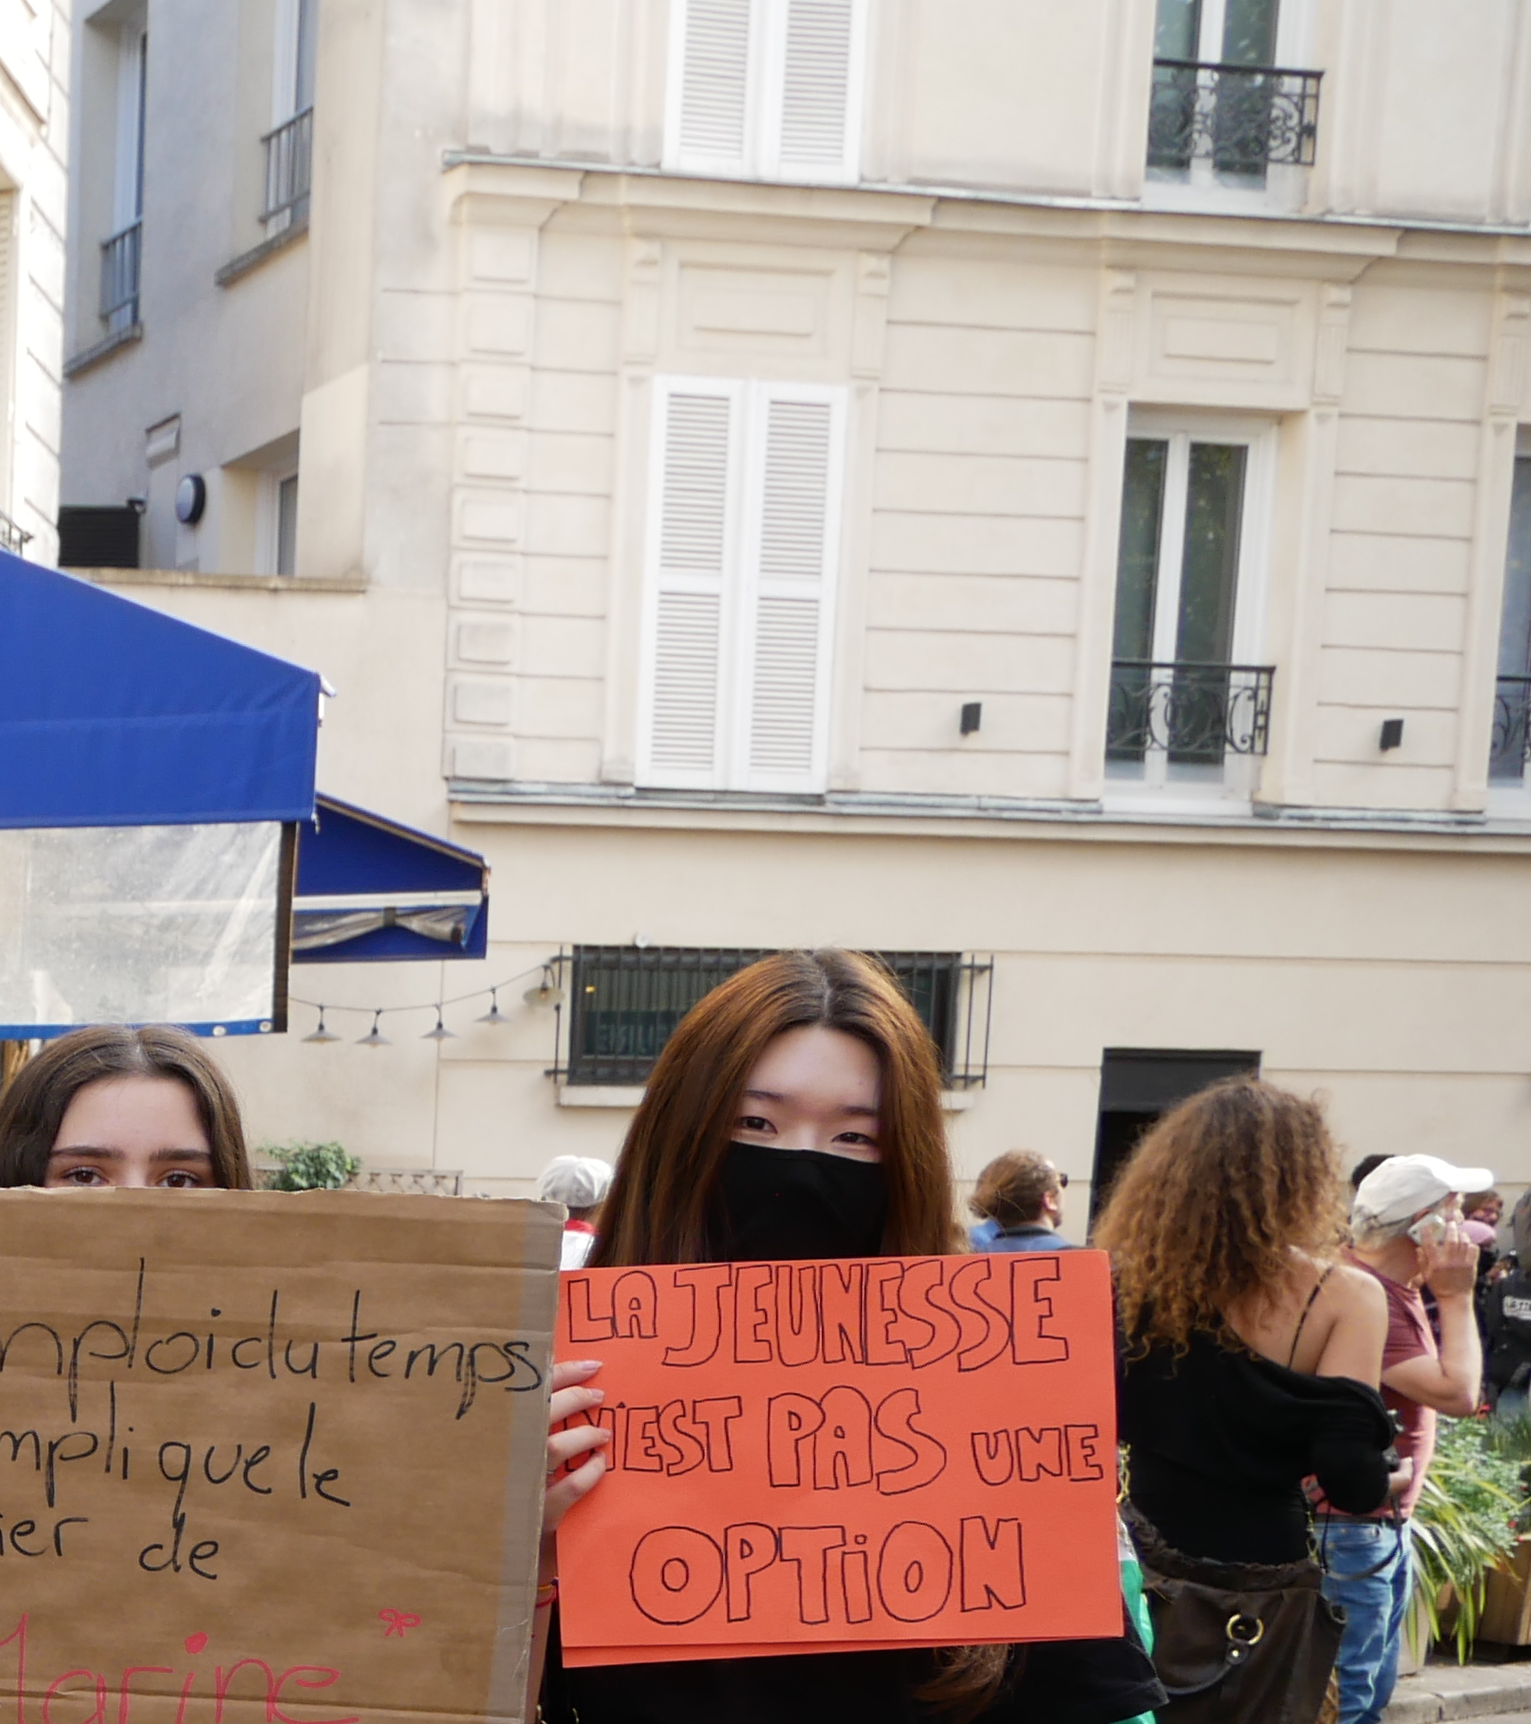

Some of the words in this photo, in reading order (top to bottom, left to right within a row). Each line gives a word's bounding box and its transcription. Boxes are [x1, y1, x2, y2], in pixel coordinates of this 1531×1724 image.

[568, 1270, 657, 1343] LA
[662, 1257, 1069, 1372] JEUNESSE
[767, 1386, 947, 1496] PAS
[971, 1424, 1104, 1486] UNE
[139, 1512, 218, 1579] de
